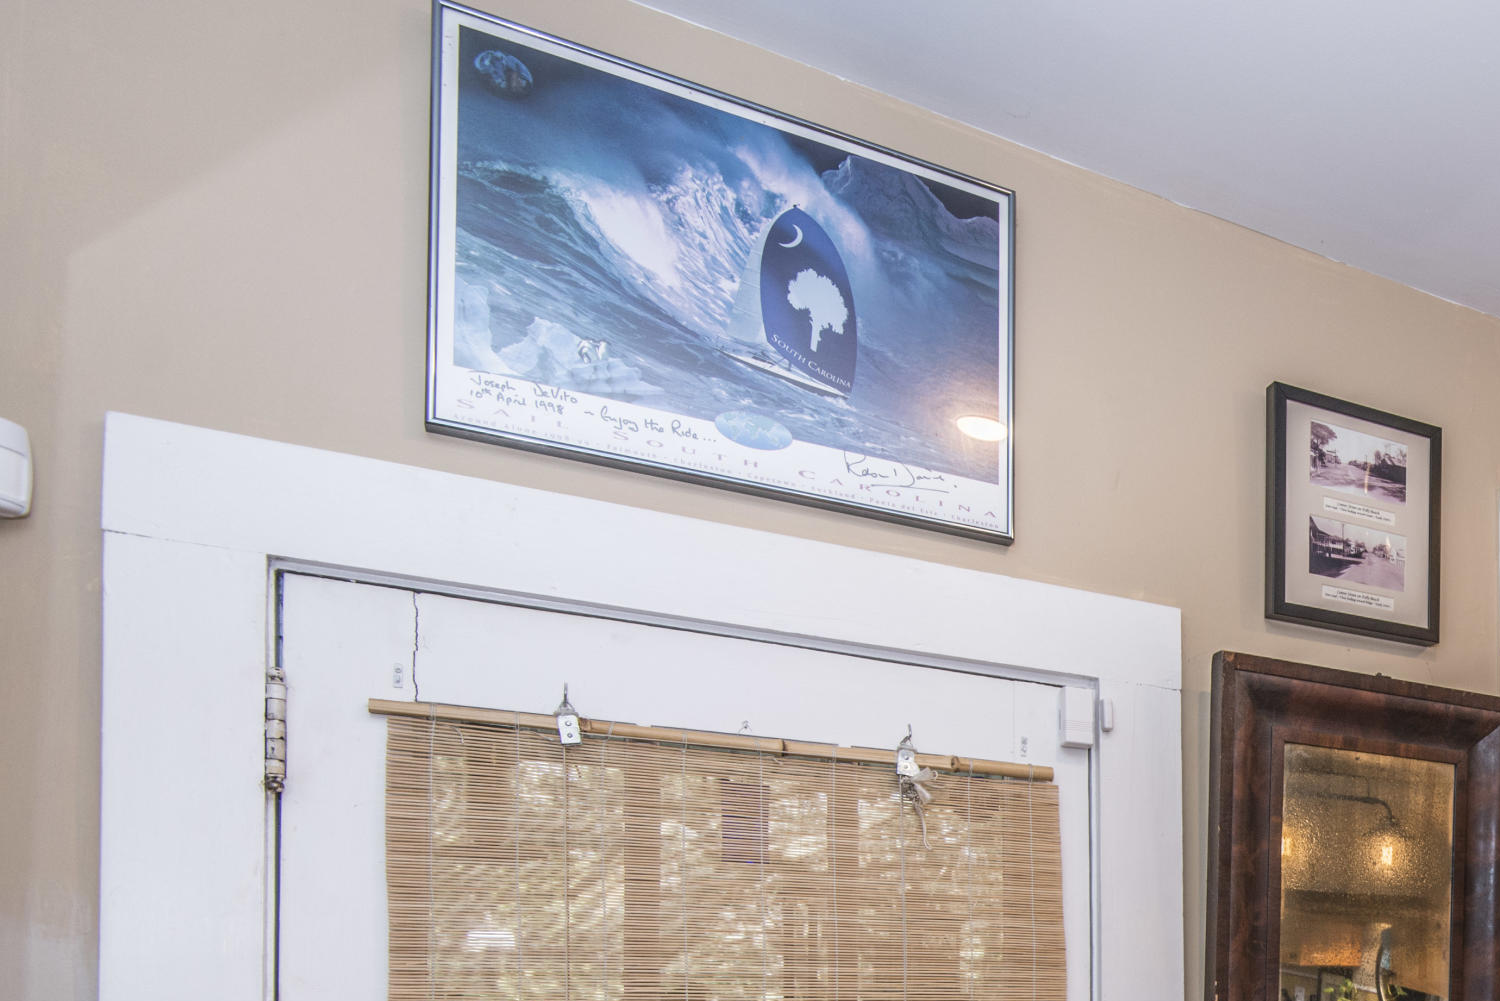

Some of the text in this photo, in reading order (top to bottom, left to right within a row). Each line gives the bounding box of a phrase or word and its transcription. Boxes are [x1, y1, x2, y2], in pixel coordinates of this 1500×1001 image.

[772, 334, 851, 388] SOUTH CAROLINA
[534, 399, 565, 416] 1998
[613, 430, 758, 468] SOUTH
[798, 469, 996, 518] CAROLINA
